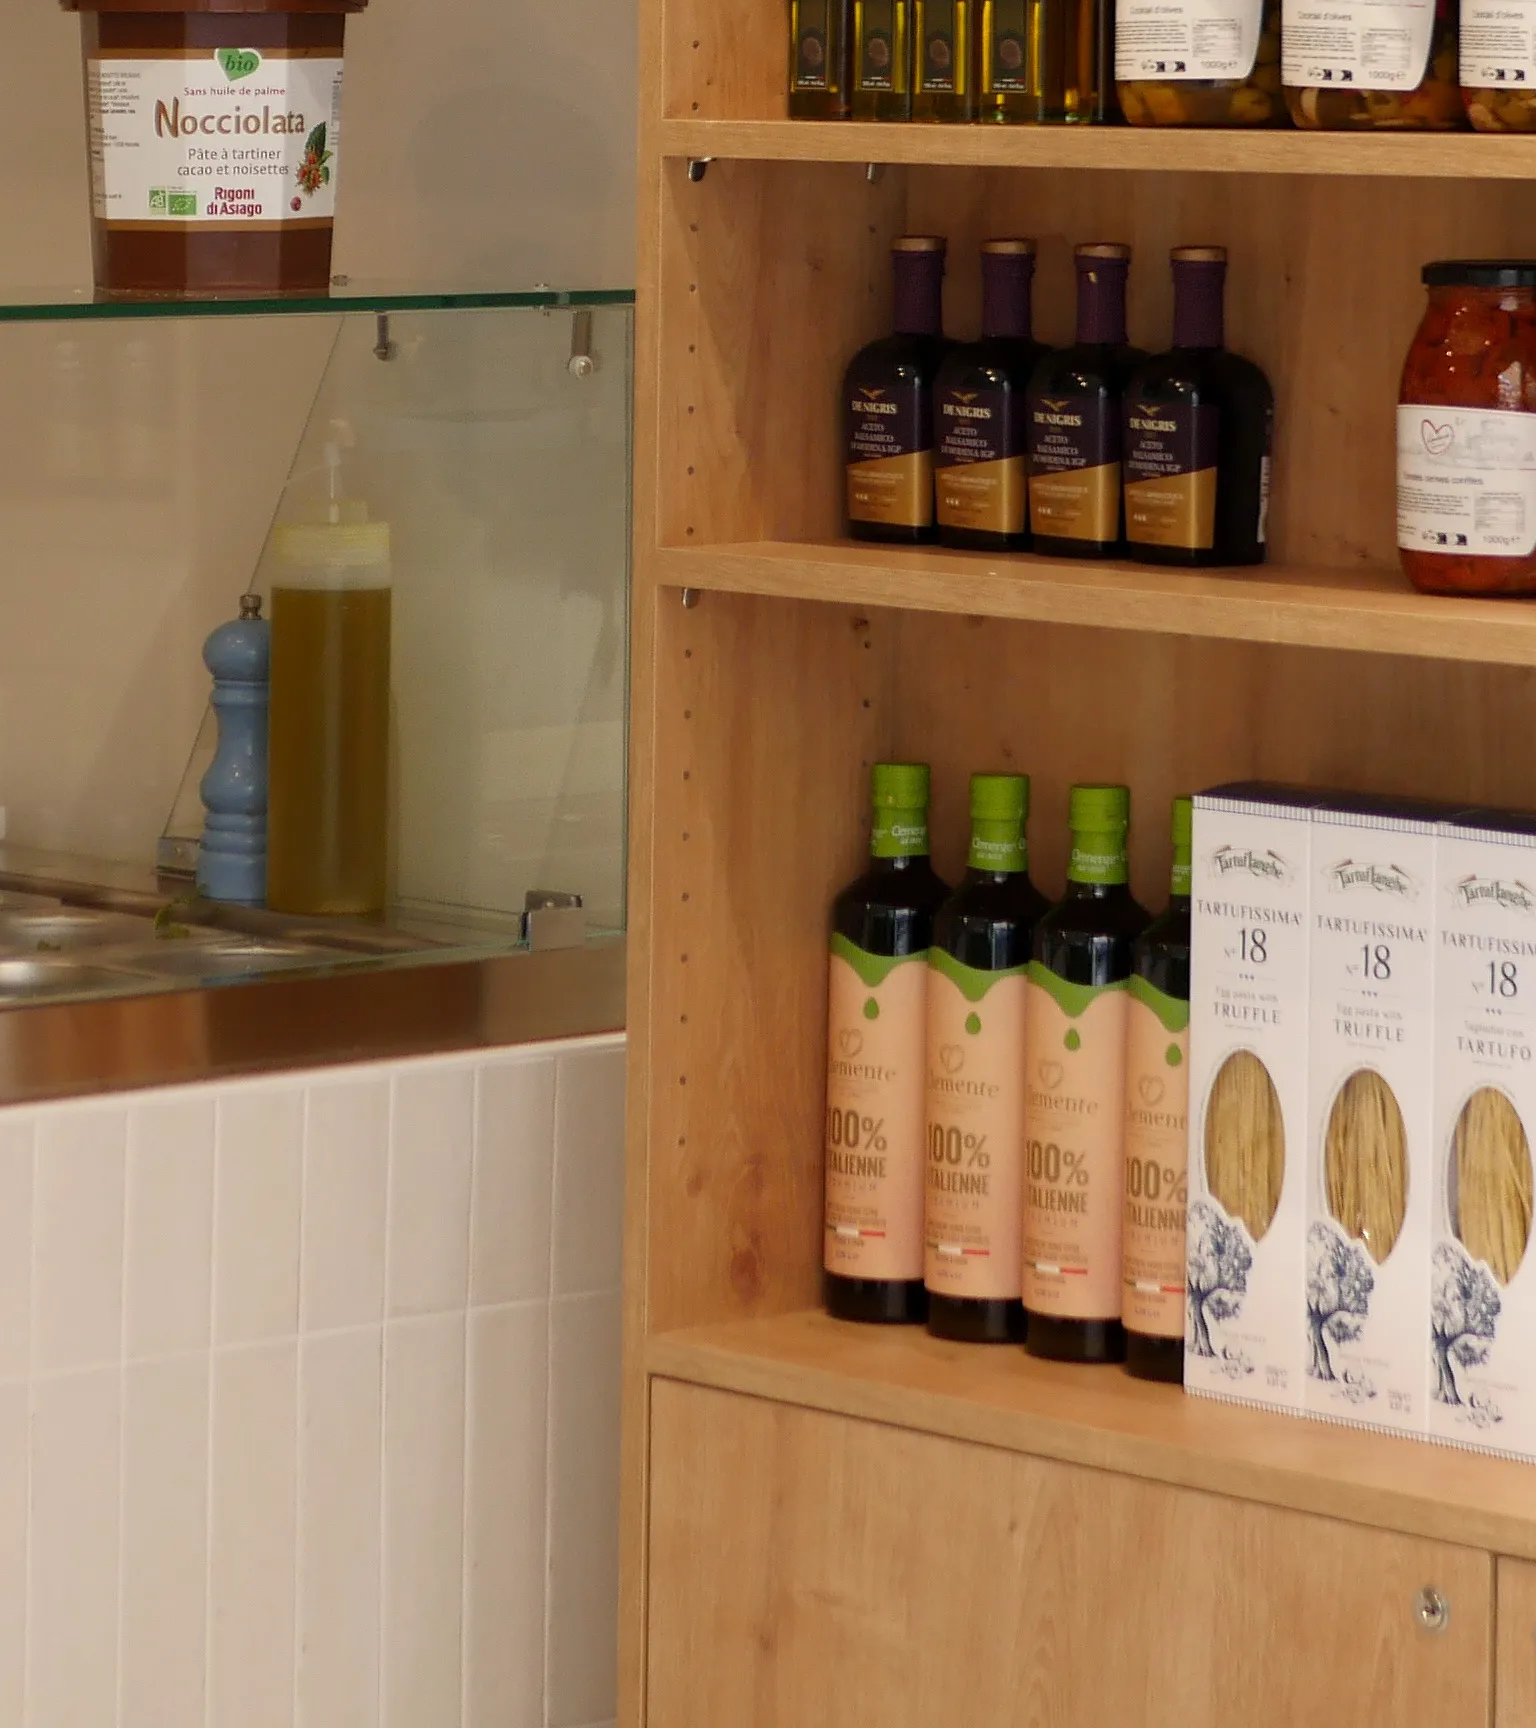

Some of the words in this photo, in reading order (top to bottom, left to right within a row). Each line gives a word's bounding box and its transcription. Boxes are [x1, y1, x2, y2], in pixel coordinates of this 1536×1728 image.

[225, 55, 254, 72] bio
[184, 87, 207, 97] Sans
[210, 86, 236, 96] huile
[238, 86, 251, 96] de
[254, 86, 286, 98] palme
[154, 96, 305, 138] Nocciolata
[188, 147, 217, 161] Pâte
[221, 148, 229, 160] à
[232, 148, 281, 160] tartiner
[177, 165, 212, 176] cacao
[216, 164, 229, 176] et
[232, 163, 289, 176] noisettes
[214, 186, 255, 203] Rigoni
[206, 202, 218, 215] di
[220, 202, 263, 217] Asiago
[1239, 928, 1267, 963] 18
[1362, 944, 1391, 980] 18
[1487, 960, 1518, 997] 18
[1214, 1001, 1281, 1024] TRUFFLE
[1333, 1019, 1404, 1042] TRUFFLE
[1456, 1036, 1532, 1061] TARTUFO
[928, 1123, 990, 1169] 100%
[1026, 1140, 1089, 1186] 100%
